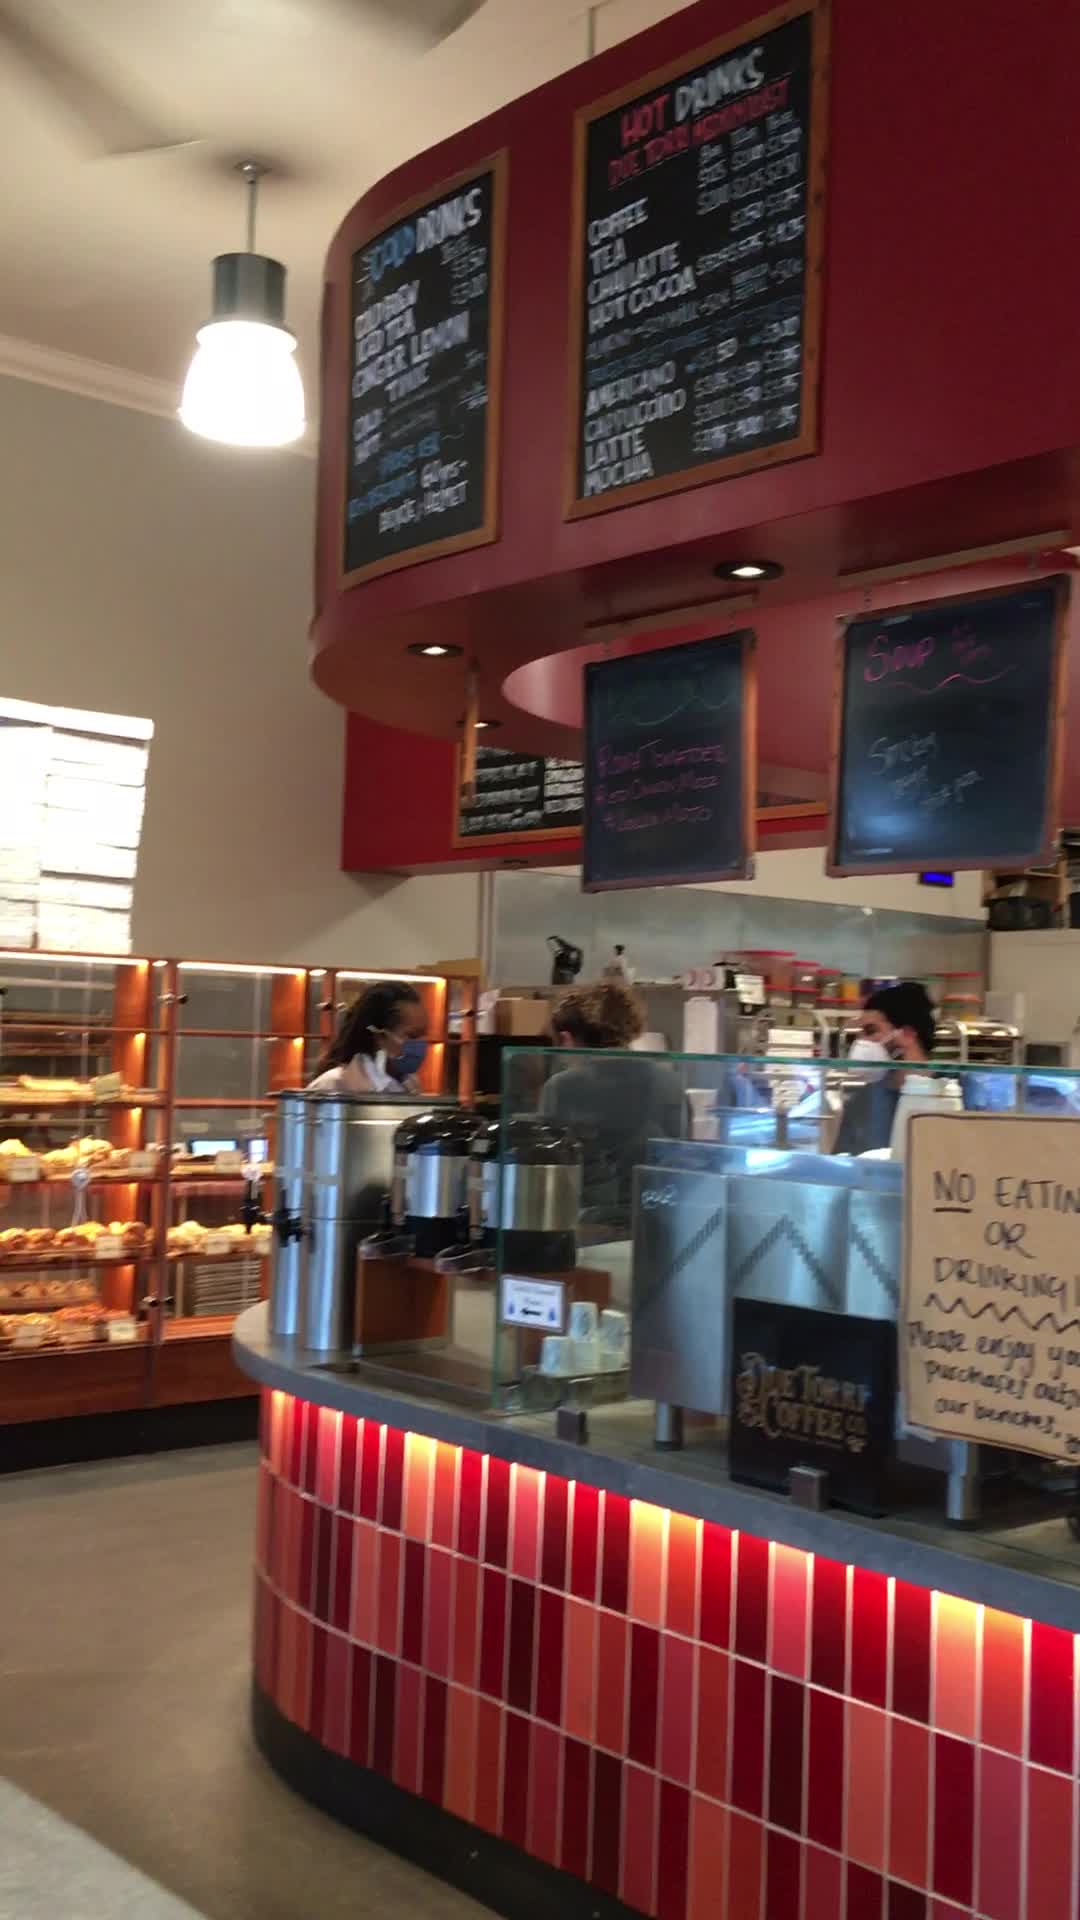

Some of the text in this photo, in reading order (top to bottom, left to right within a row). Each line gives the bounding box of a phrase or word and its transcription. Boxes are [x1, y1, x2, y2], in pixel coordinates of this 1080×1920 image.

[620, 46, 765, 149] HOT DRINKS
[587, 196, 649, 247] COFFEE
[589, 237, 627, 276] TEA
[636, 240, 681, 284] LATTE
[587, 294, 626, 335] HOT
[627, 265, 697, 316] COCOA
[386, 306, 416, 346] TEA
[410, 310, 470, 364] LEMON
[585, 360, 677, 417] AMERICANO
[585, 388, 688, 443] CAPPUCCINO
[585, 425, 647, 471] LATTE
[584, 451, 655, 498] MOCHA
[934, 1168, 976, 1204] NO
[984, 1220, 1036, 1260] OR
[933, 1256, 1067, 1313] DRINKING
[907, 1321, 968, 1352] Please
[975, 1335, 1036, 1379] enjoy
[925, 1360, 1027, 1400] purchases
[762, 1392, 844, 1440] COFFEE
[935, 1398, 969, 1414] our
